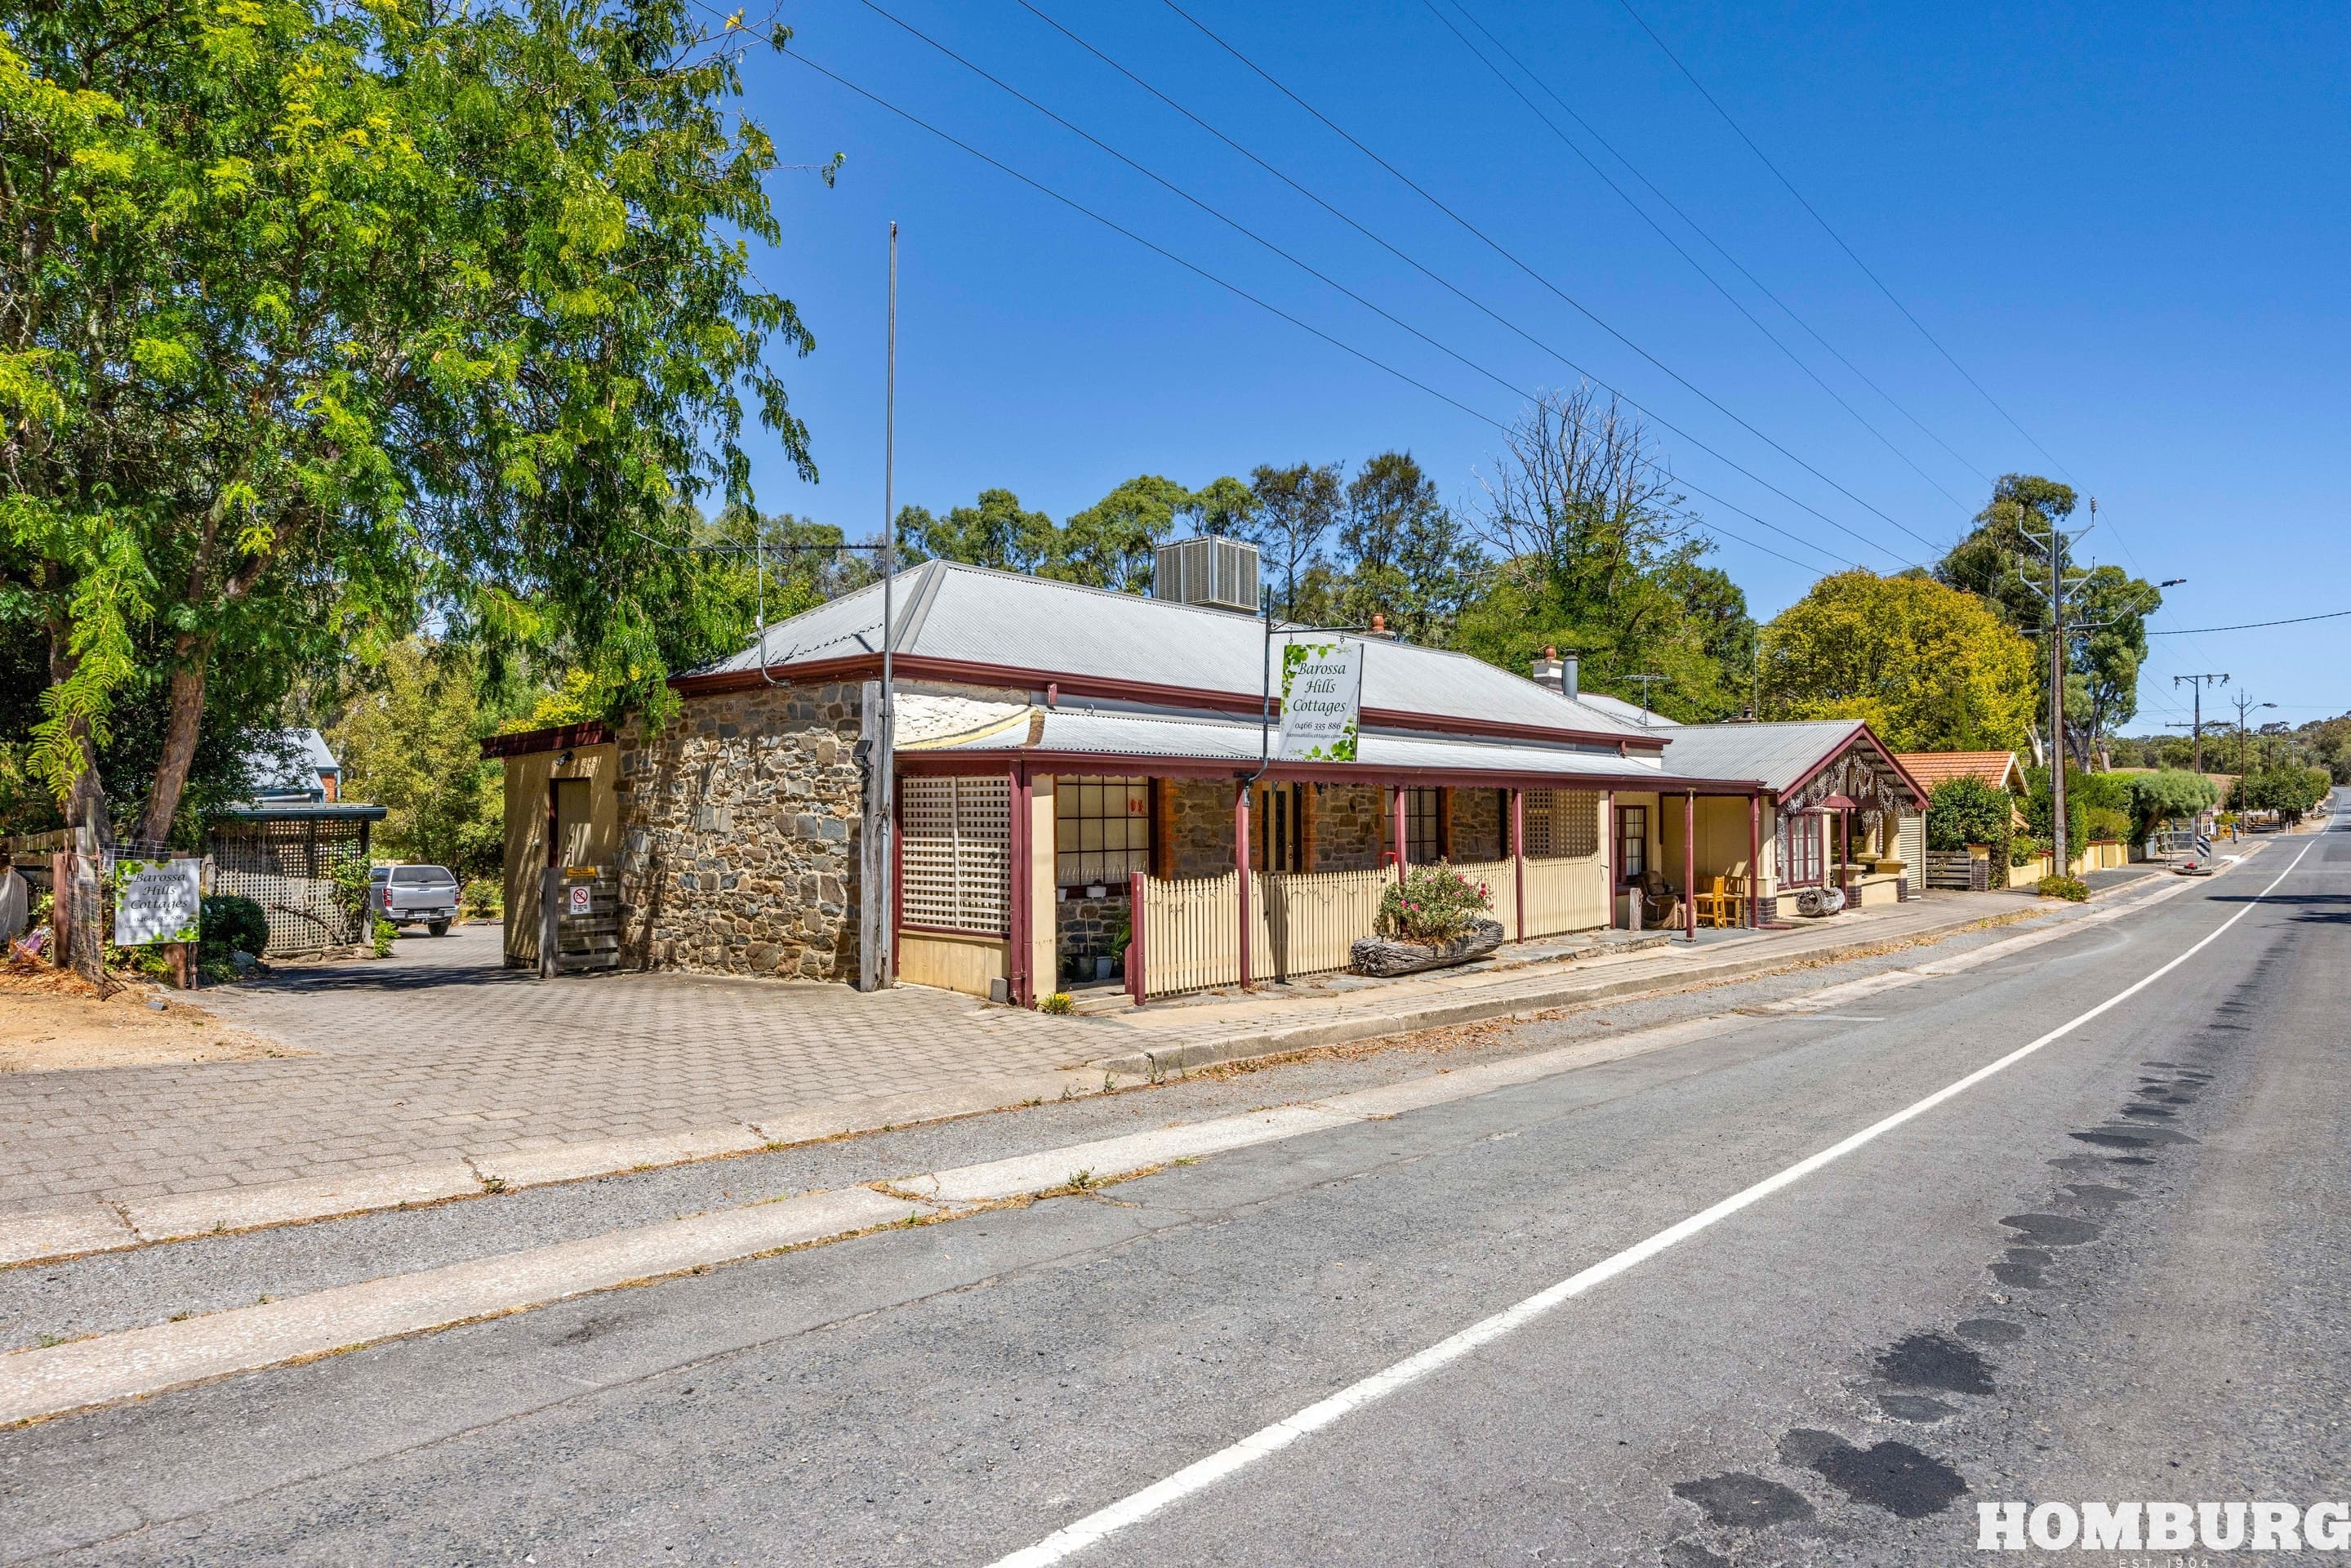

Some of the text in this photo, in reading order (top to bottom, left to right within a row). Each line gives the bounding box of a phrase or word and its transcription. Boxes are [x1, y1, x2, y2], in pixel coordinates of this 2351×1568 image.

[1297, 662, 1346, 675] Barossa
[1304, 679, 1336, 693] Hills
[1293, 698, 1347, 716] Cottages
[1294, 722, 1342, 731] 0466 335 886
[134, 873, 186, 883] Barossa
[142, 884, 176, 896] Hills
[131, 899, 188, 912] Cottages
